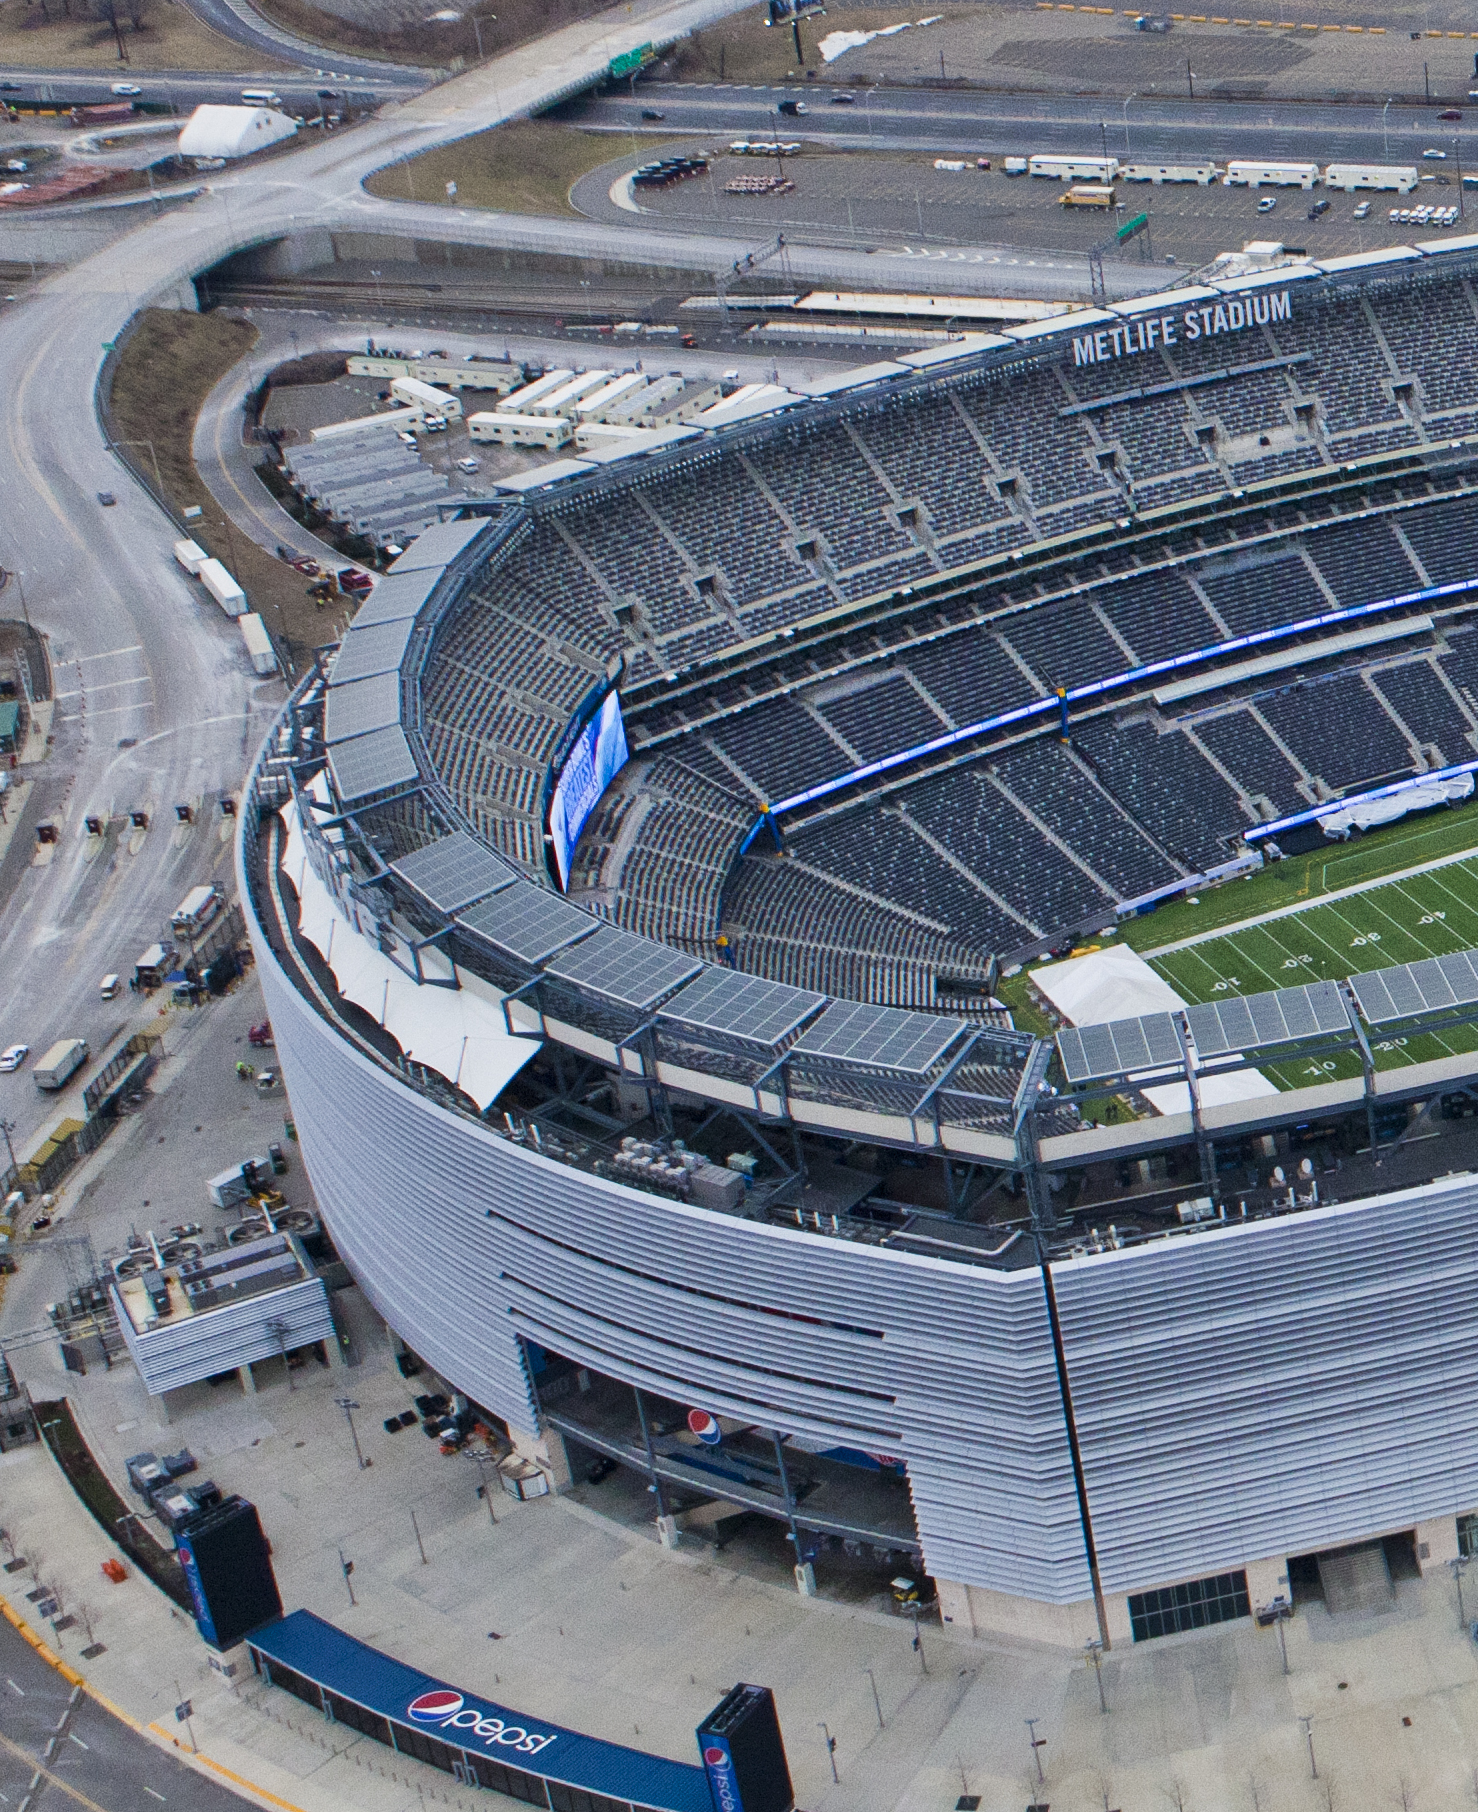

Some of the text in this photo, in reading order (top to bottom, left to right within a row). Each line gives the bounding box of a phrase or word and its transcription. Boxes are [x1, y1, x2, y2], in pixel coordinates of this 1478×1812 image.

[1072, 291, 1292, 367] METLIFE STADIUM
[1421, 910, 1446, 925] 40
[1354, 931, 1382, 947] 30
[1285, 953, 1313, 969] 20
[1217, 976, 1241, 991] 10
[1308, 1060, 1337, 1077] 10
[440, 1709, 558, 1755] pepsi
[713, 1774, 736, 1812] epsi
